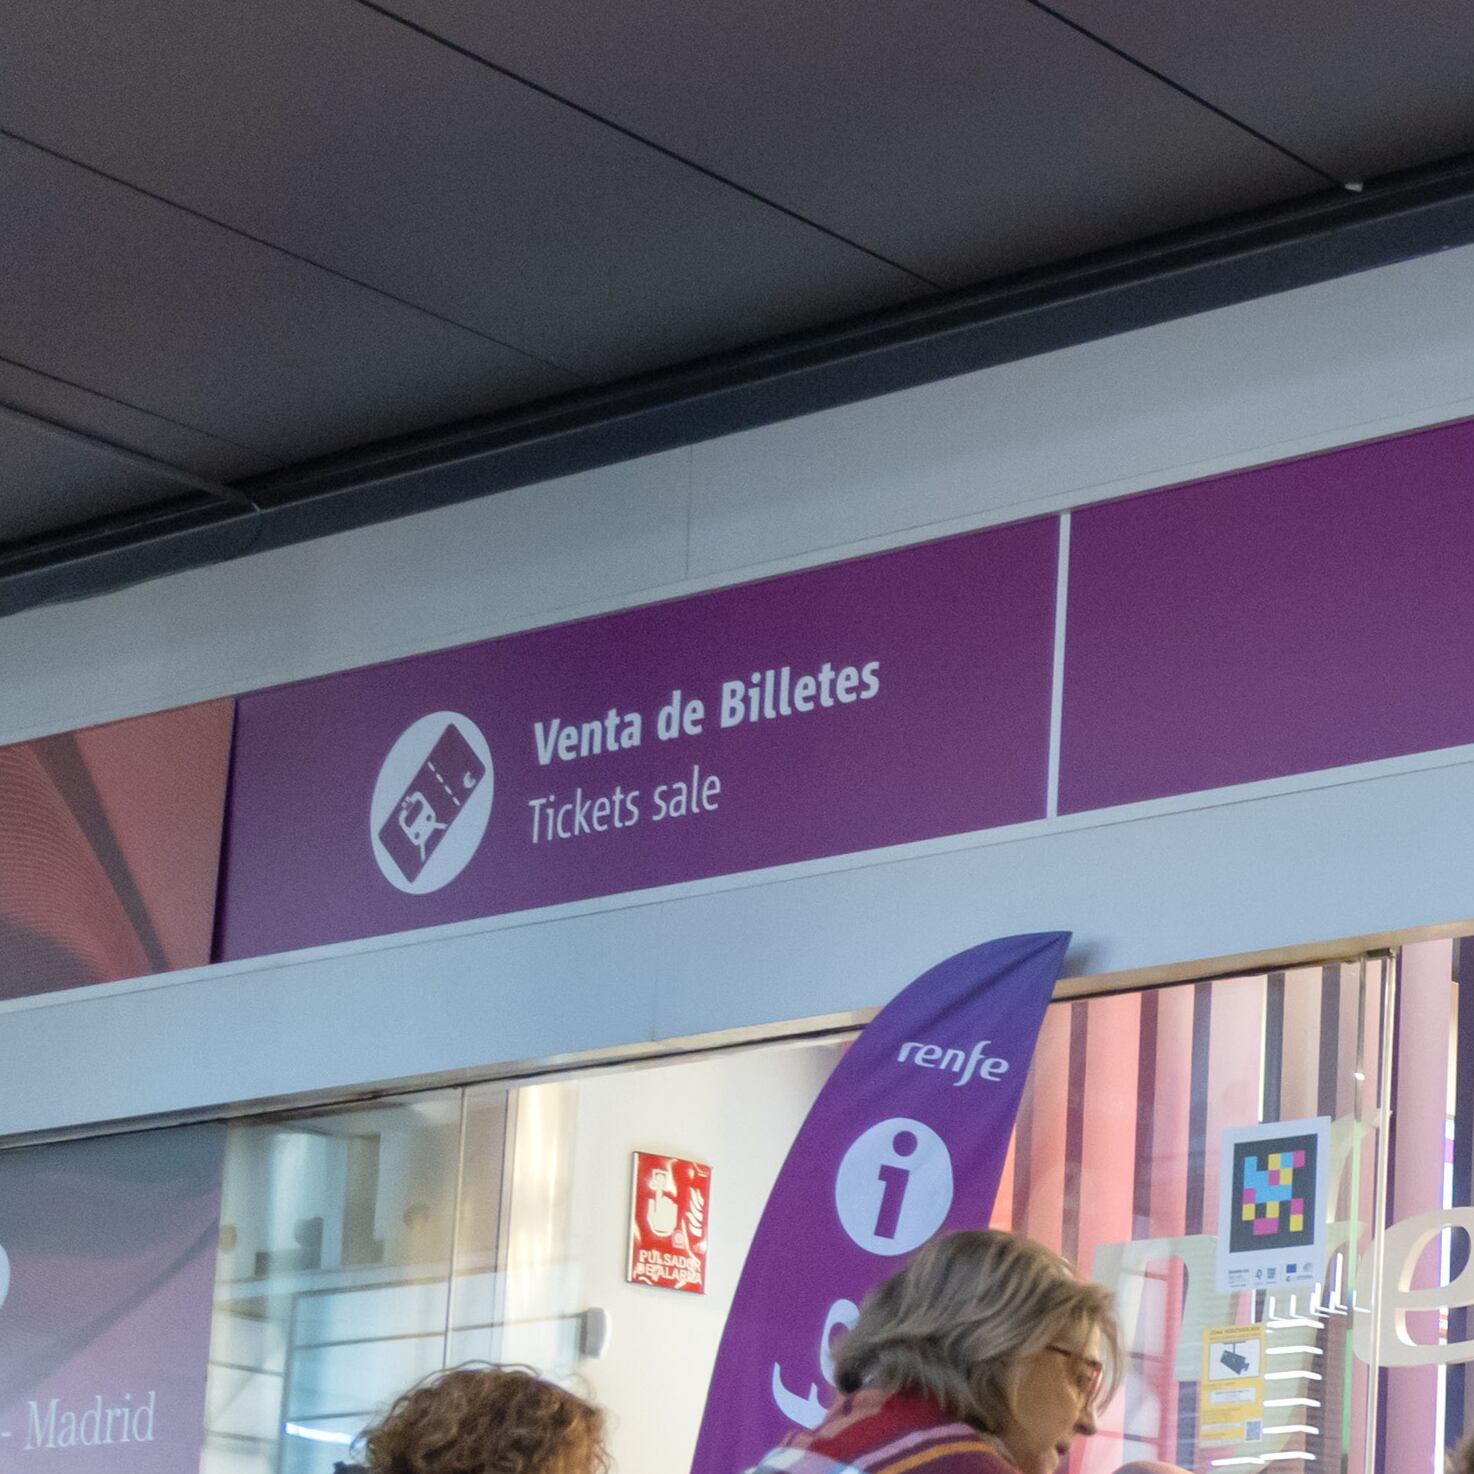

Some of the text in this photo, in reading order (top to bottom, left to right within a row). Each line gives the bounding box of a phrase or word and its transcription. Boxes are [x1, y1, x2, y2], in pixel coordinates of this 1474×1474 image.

[533, 658, 882, 766] Venta de Billetes
[528, 764, 723, 845] Tickets sale
[896, 1039, 1010, 1088] renfe
[638, 1248, 702, 1273] PULSADOR
[22, 1390, 157, 1451] Madrid
